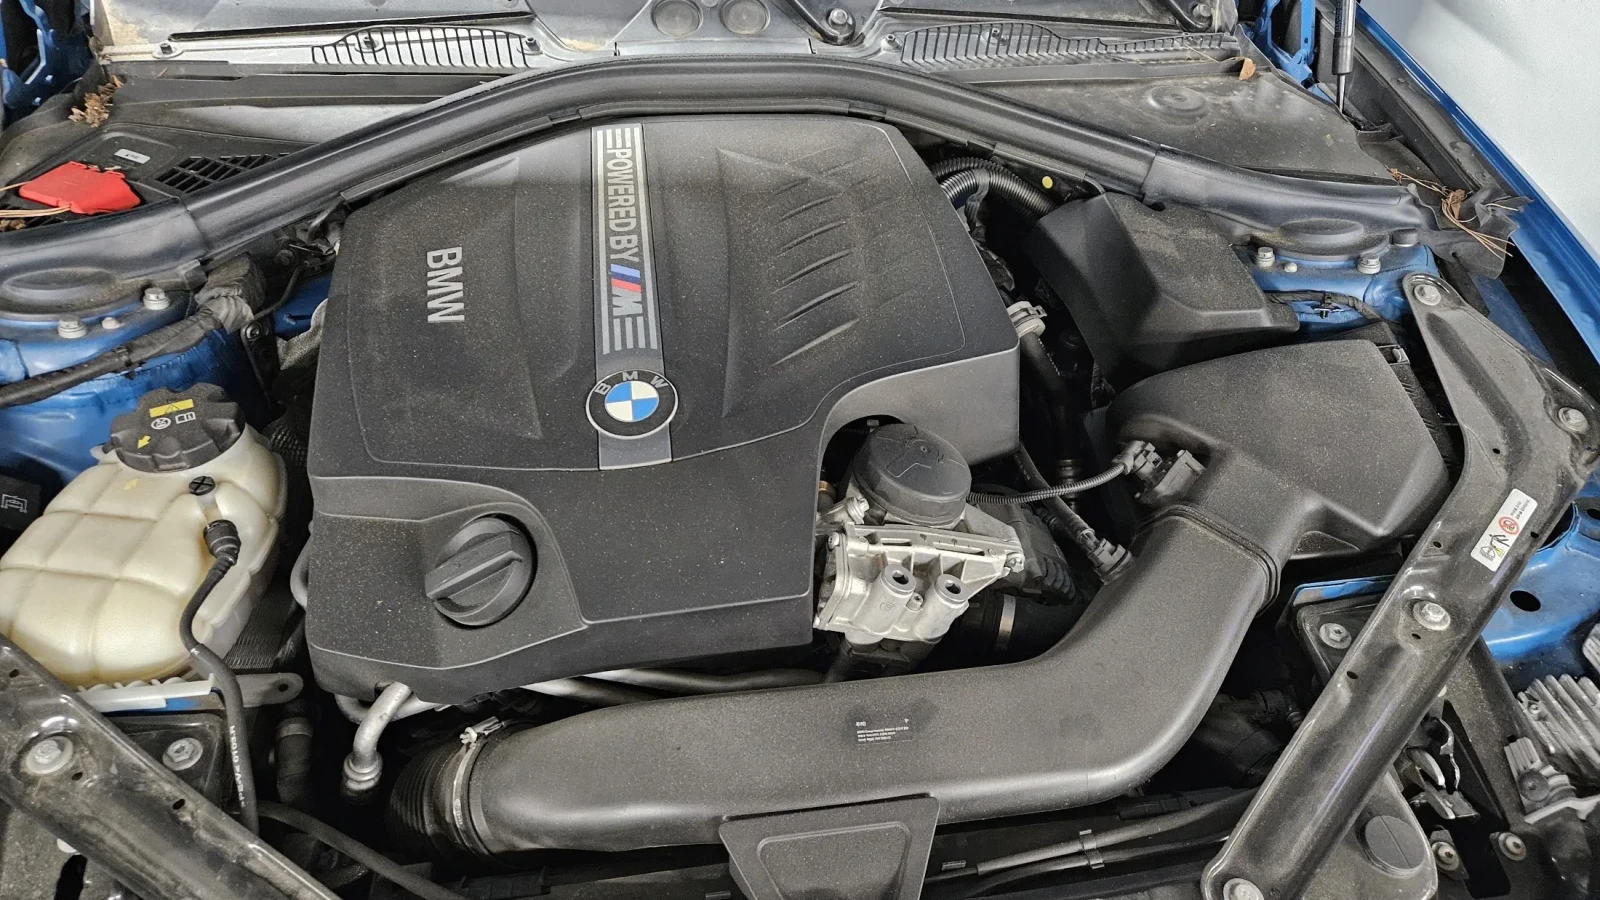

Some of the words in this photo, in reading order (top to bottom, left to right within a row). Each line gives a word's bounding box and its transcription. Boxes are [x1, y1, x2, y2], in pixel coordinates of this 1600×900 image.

[606, 148, 637, 232] POWERED
[609, 234, 640, 262] BY
[427, 246, 465, 323] BMW
[595, 370, 669, 396] BMW
